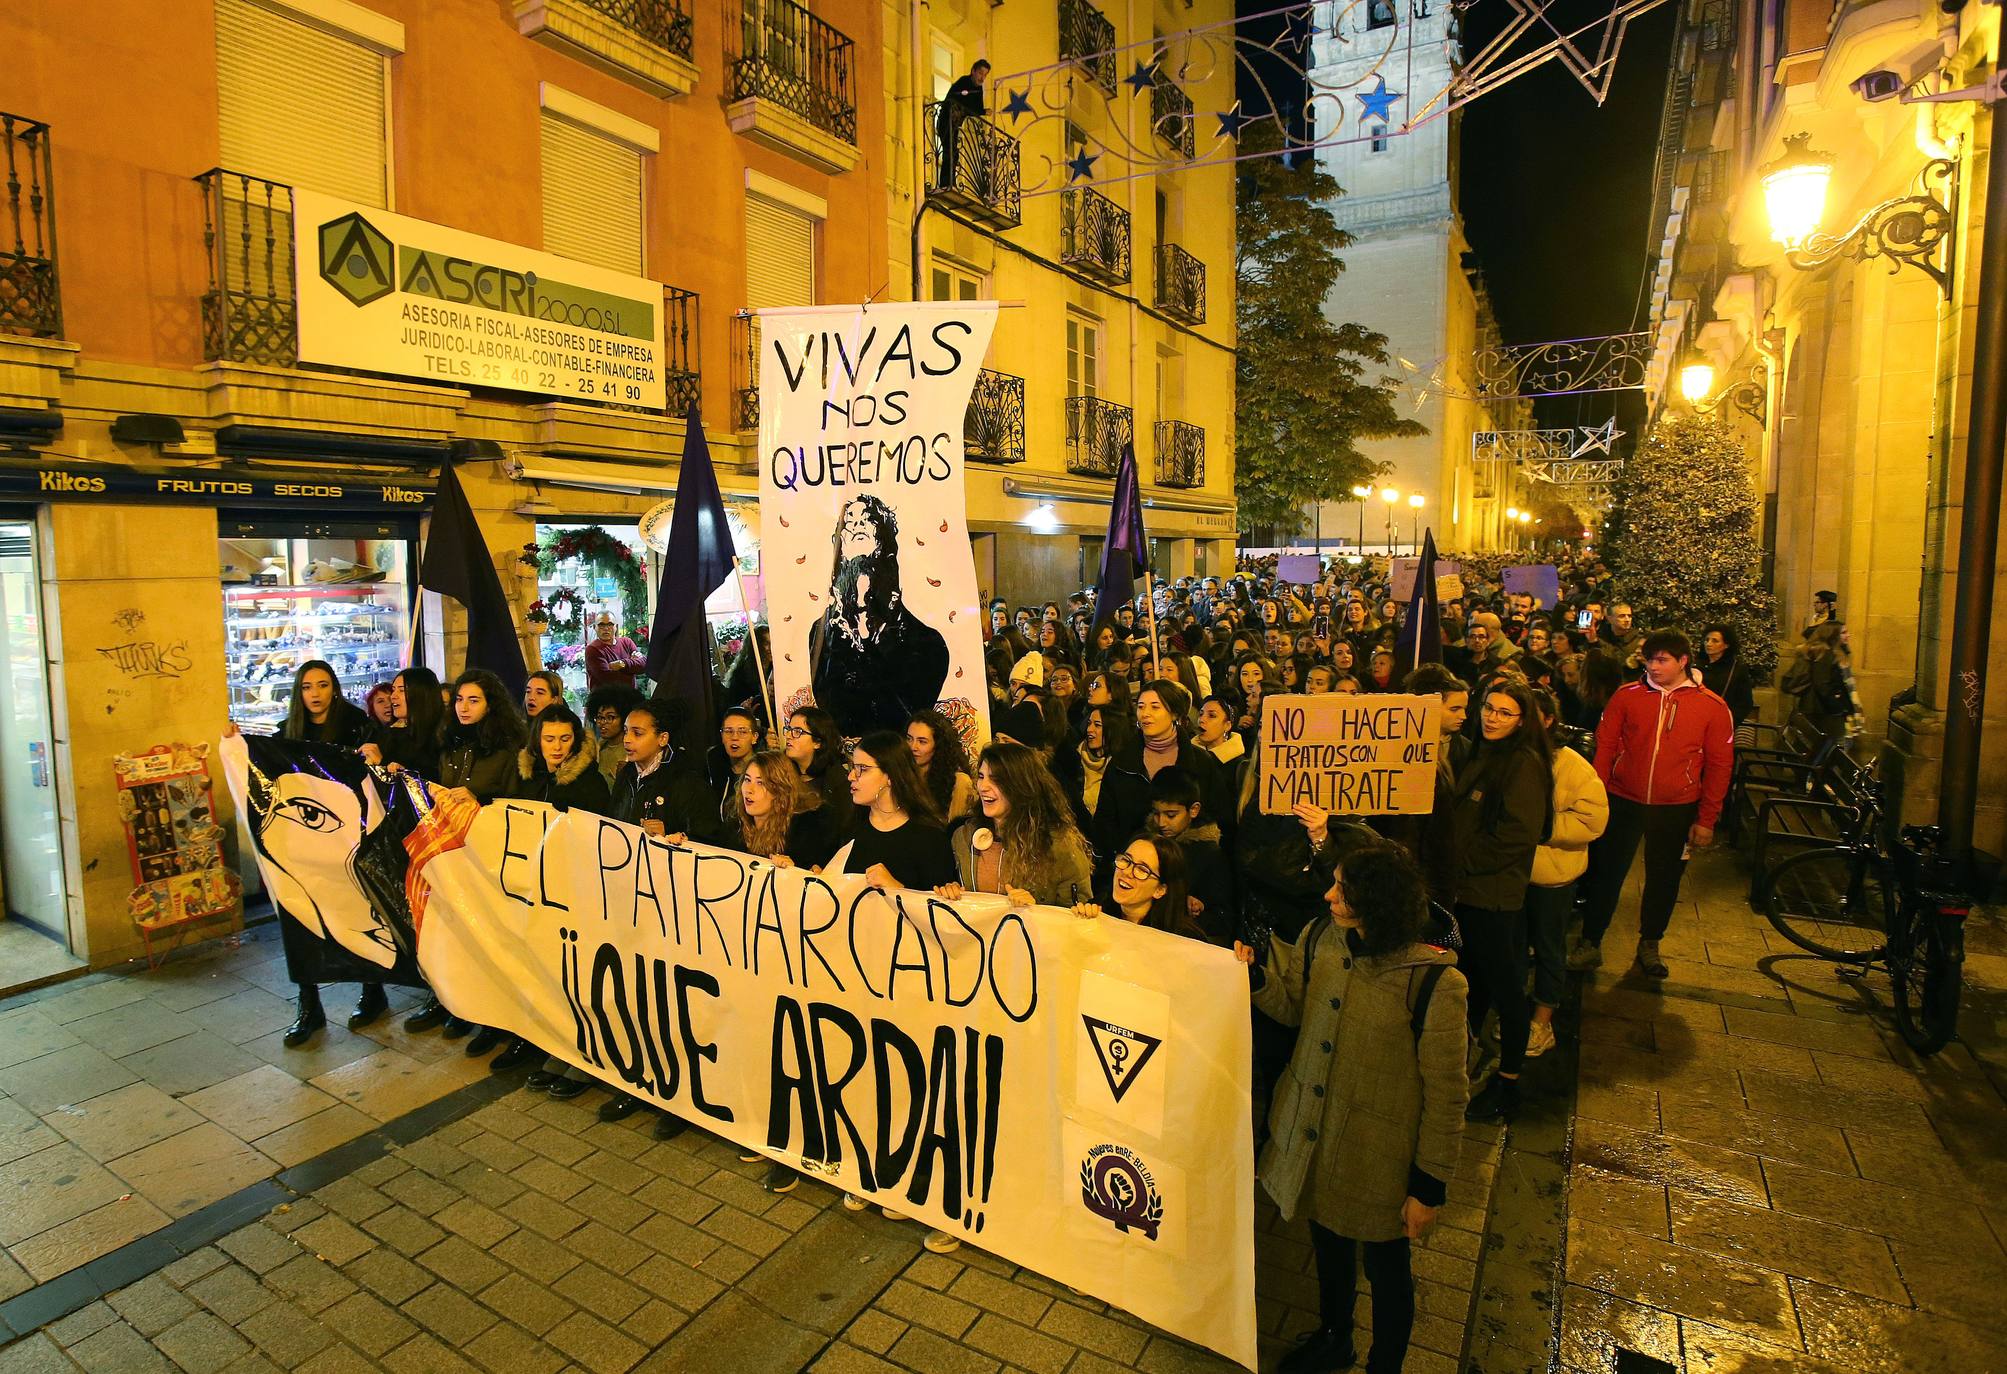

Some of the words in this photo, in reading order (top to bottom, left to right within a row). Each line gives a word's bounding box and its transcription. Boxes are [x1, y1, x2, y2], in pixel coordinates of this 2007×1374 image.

[402, 303, 471, 331] ASESORIA
[476, 316, 585, 351] FISCAL-ASESORES
[588, 338, 602, 354] DE
[606, 341, 653, 364] EMPRESA
[774, 321, 972, 392] VIVAS
[424, 354, 476, 378] TELS.
[482, 364, 501, 381] 25
[511, 368, 529, 385] 40
[538, 372, 556, 389] 22
[578, 378, 594, 394] 25
[602, 381, 617, 397] 41
[625, 384, 641, 400] 90
[822, 391, 909, 431] NOS
[39, 471, 106, 493] Kikos
[772, 432, 951, 492] QUEREMOS
[157, 479, 253, 495] FRUTOS
[274, 484, 342, 497] SECOS
[382, 486, 424, 503] Kikos
[1272, 707, 1305, 742] NO
[1341, 707, 1426, 740] HACEN
[1269, 744, 1348, 768] TRATOS
[1350, 745, 1377, 763] CON
[1403, 743, 1434, 764] QUE
[1268, 769, 1403, 811] MALTRATE
[500, 803, 568, 912] EL
[1105, 1023, 1134, 1039] URFEM
[767, 995, 1003, 1233] ARDA!!
[1088, 1144, 1114, 1159] Mujeres
